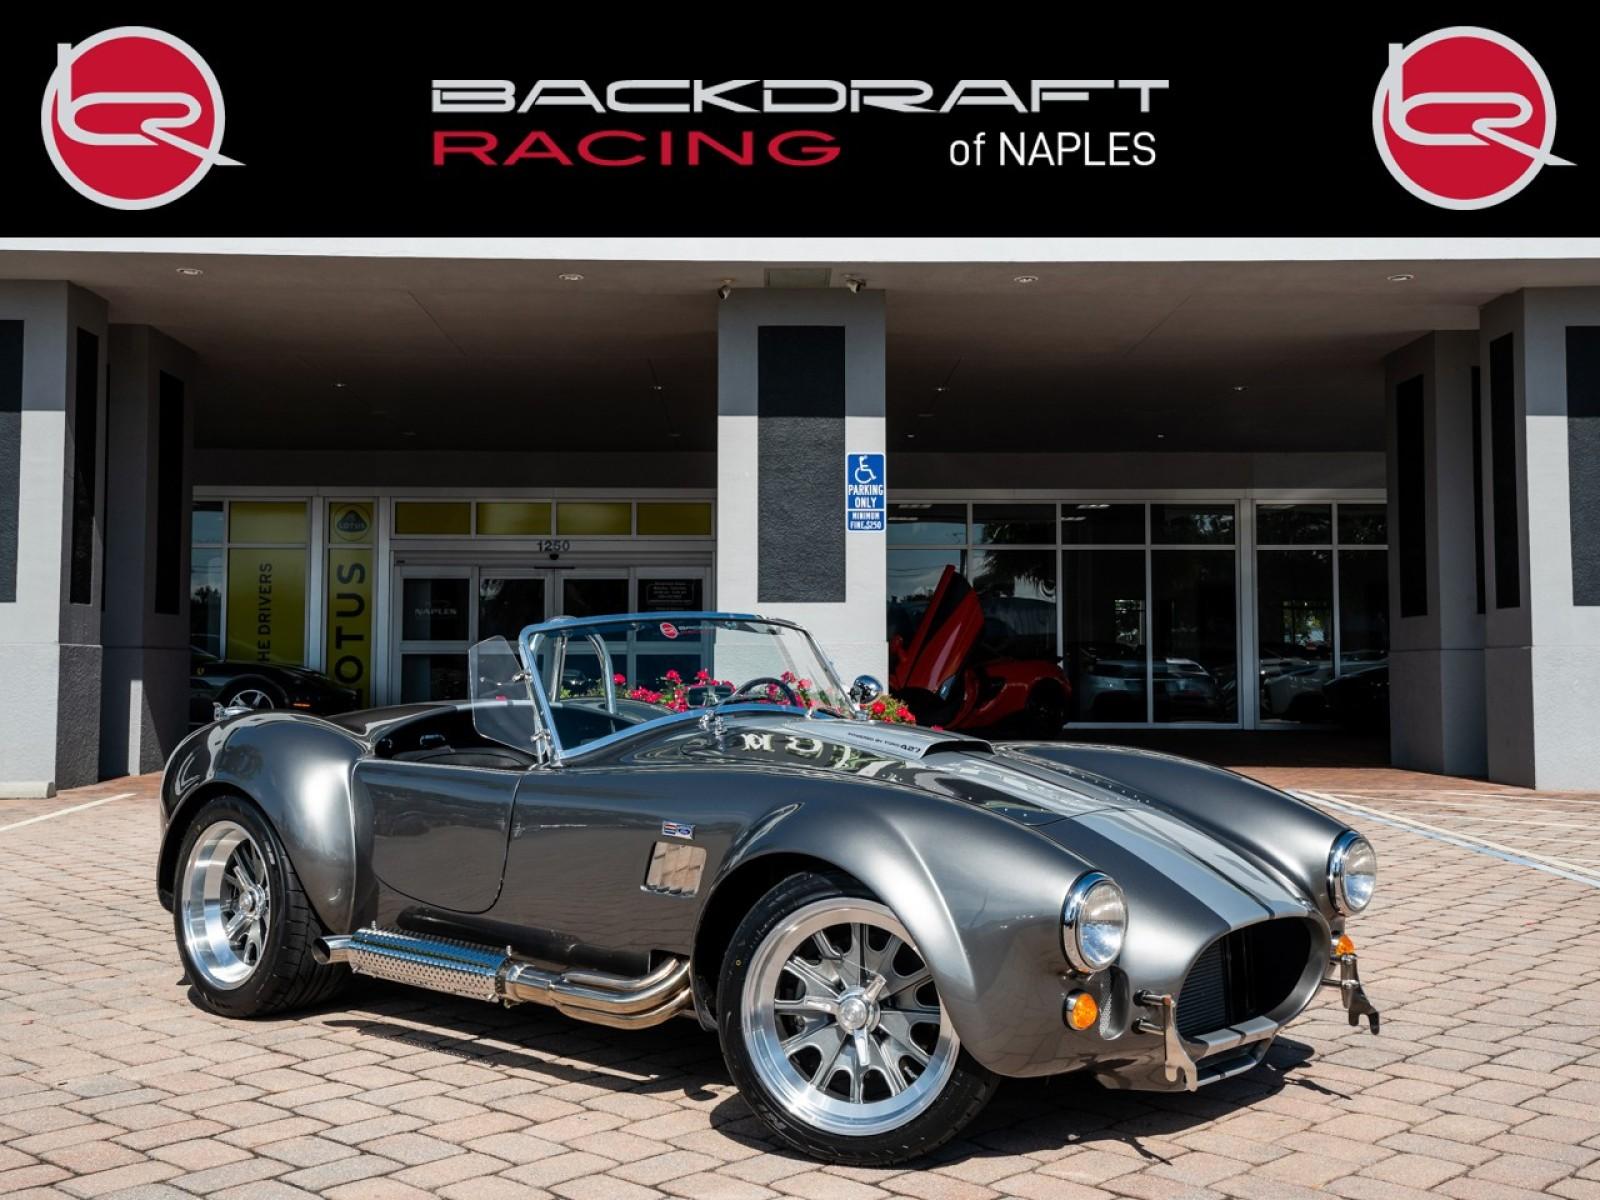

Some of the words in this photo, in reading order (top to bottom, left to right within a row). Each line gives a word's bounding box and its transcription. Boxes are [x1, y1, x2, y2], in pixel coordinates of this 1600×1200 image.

[432, 79, 1169, 113] BACKDRAFT
[433, 130, 840, 166] RACING
[949, 131, 985, 166] of
[999, 131, 1156, 166] NAPLES
[848, 485, 883, 495] PARKING
[855, 497, 876, 508] ONLY
[852, 512, 880, 520] MINIMUM
[536, 540, 570, 552] 1250
[258, 563, 272, 635] DRIVERS
[900, 744, 921, 753] 427
